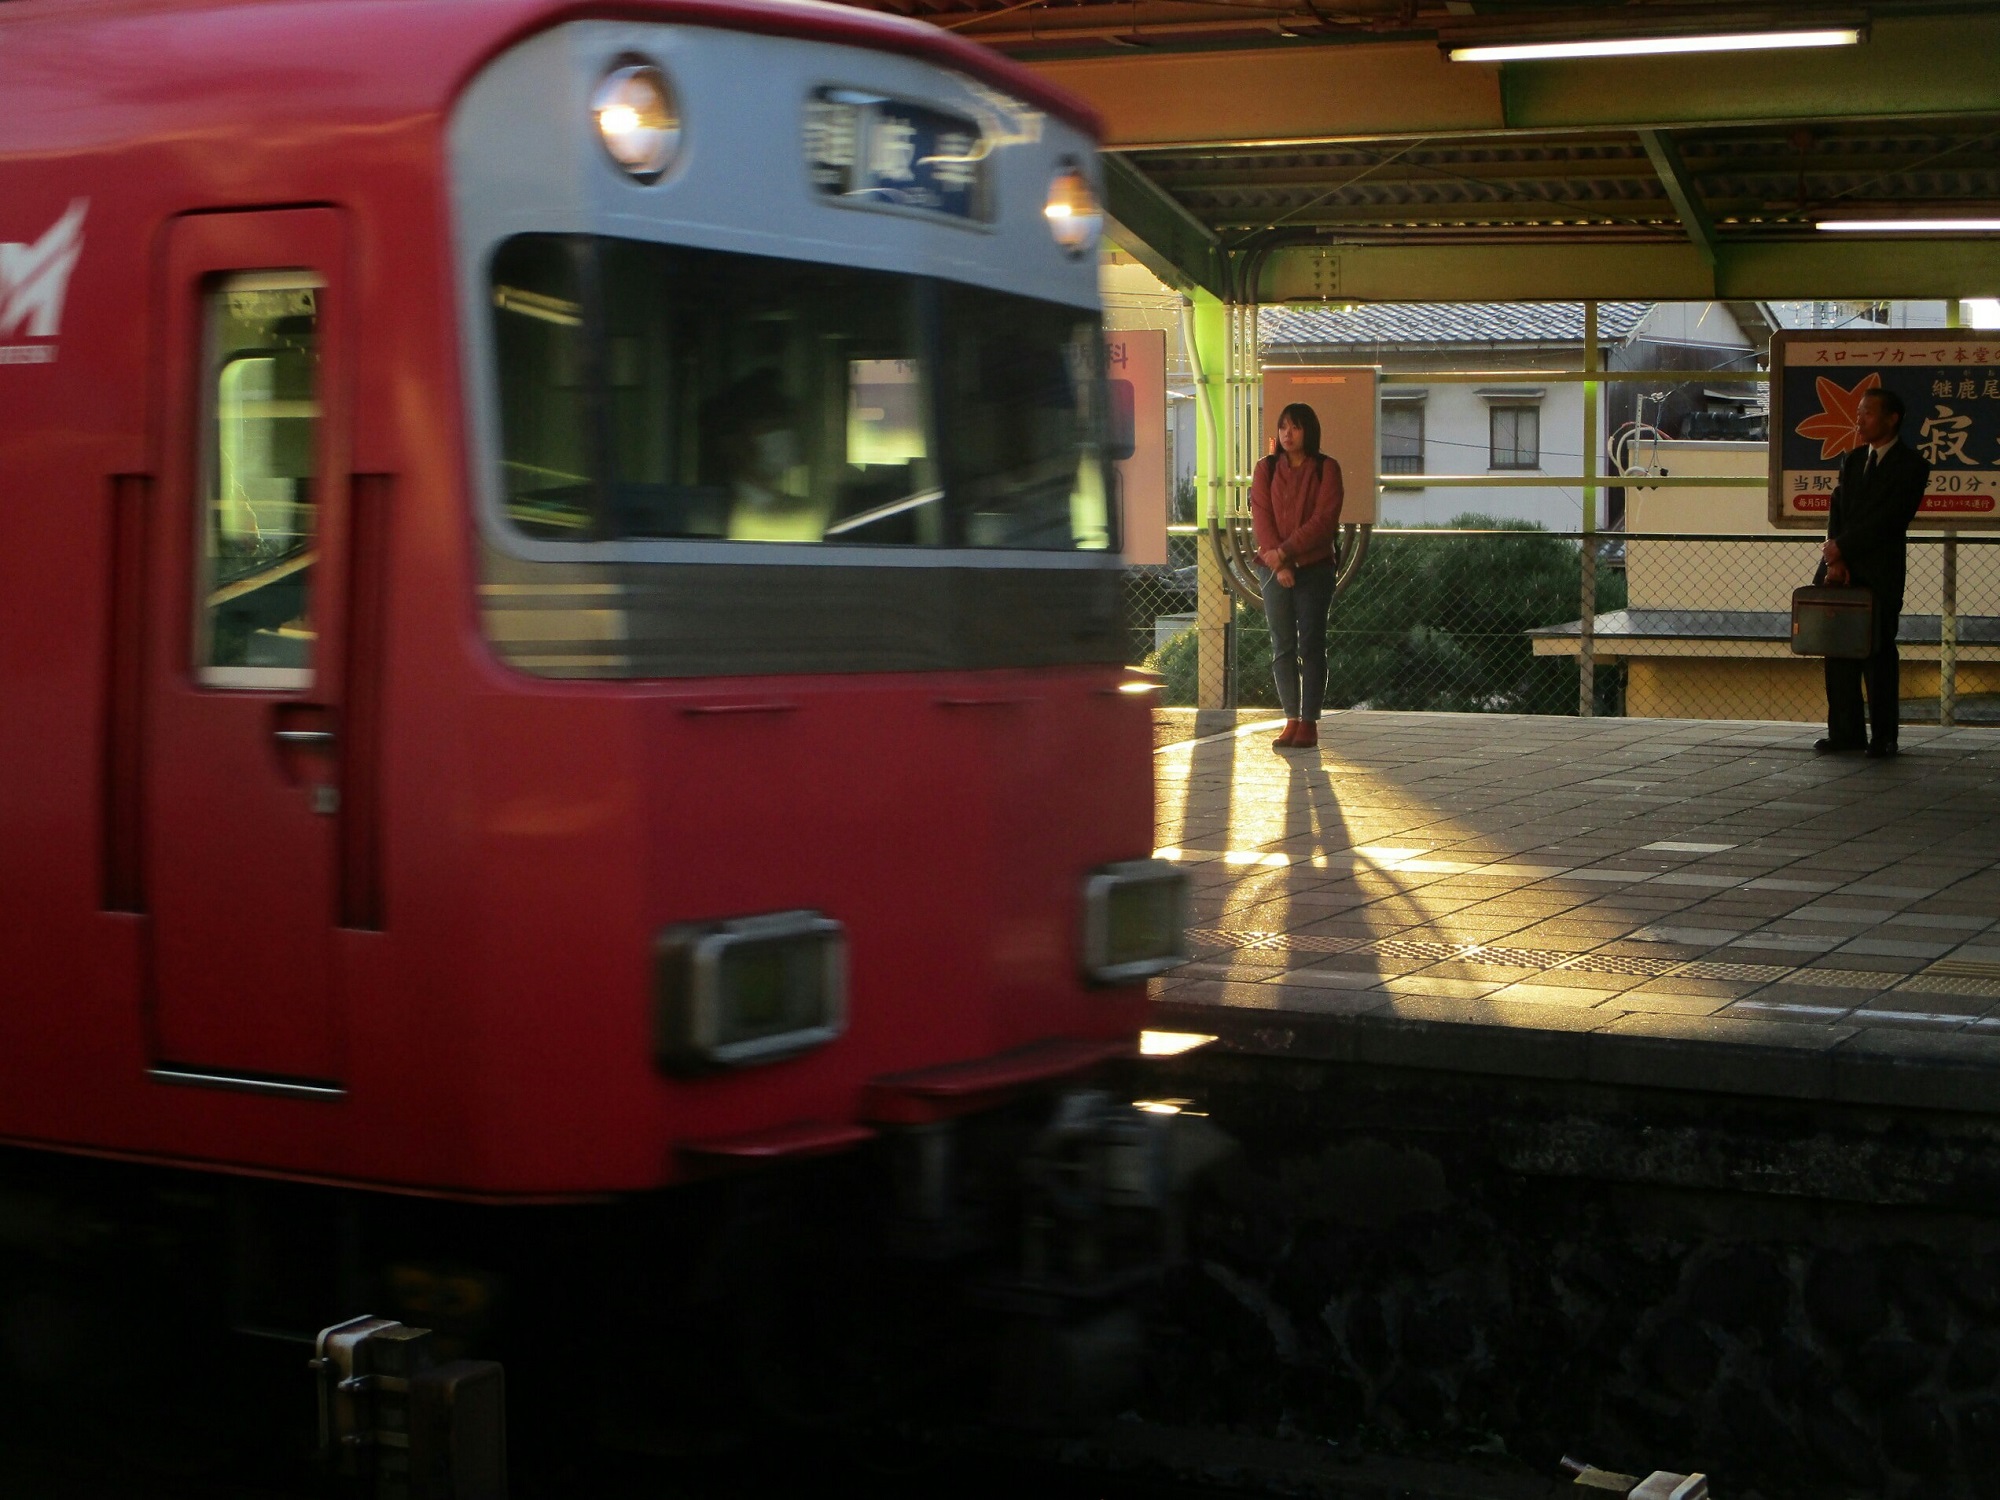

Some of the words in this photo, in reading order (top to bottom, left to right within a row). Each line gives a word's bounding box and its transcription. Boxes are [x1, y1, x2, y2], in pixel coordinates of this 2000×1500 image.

[1916, 404, 2000, 466] 寂
[1793, 475, 1840, 491] 当駅
[1798, 498, 1831, 508] 毎月5日
